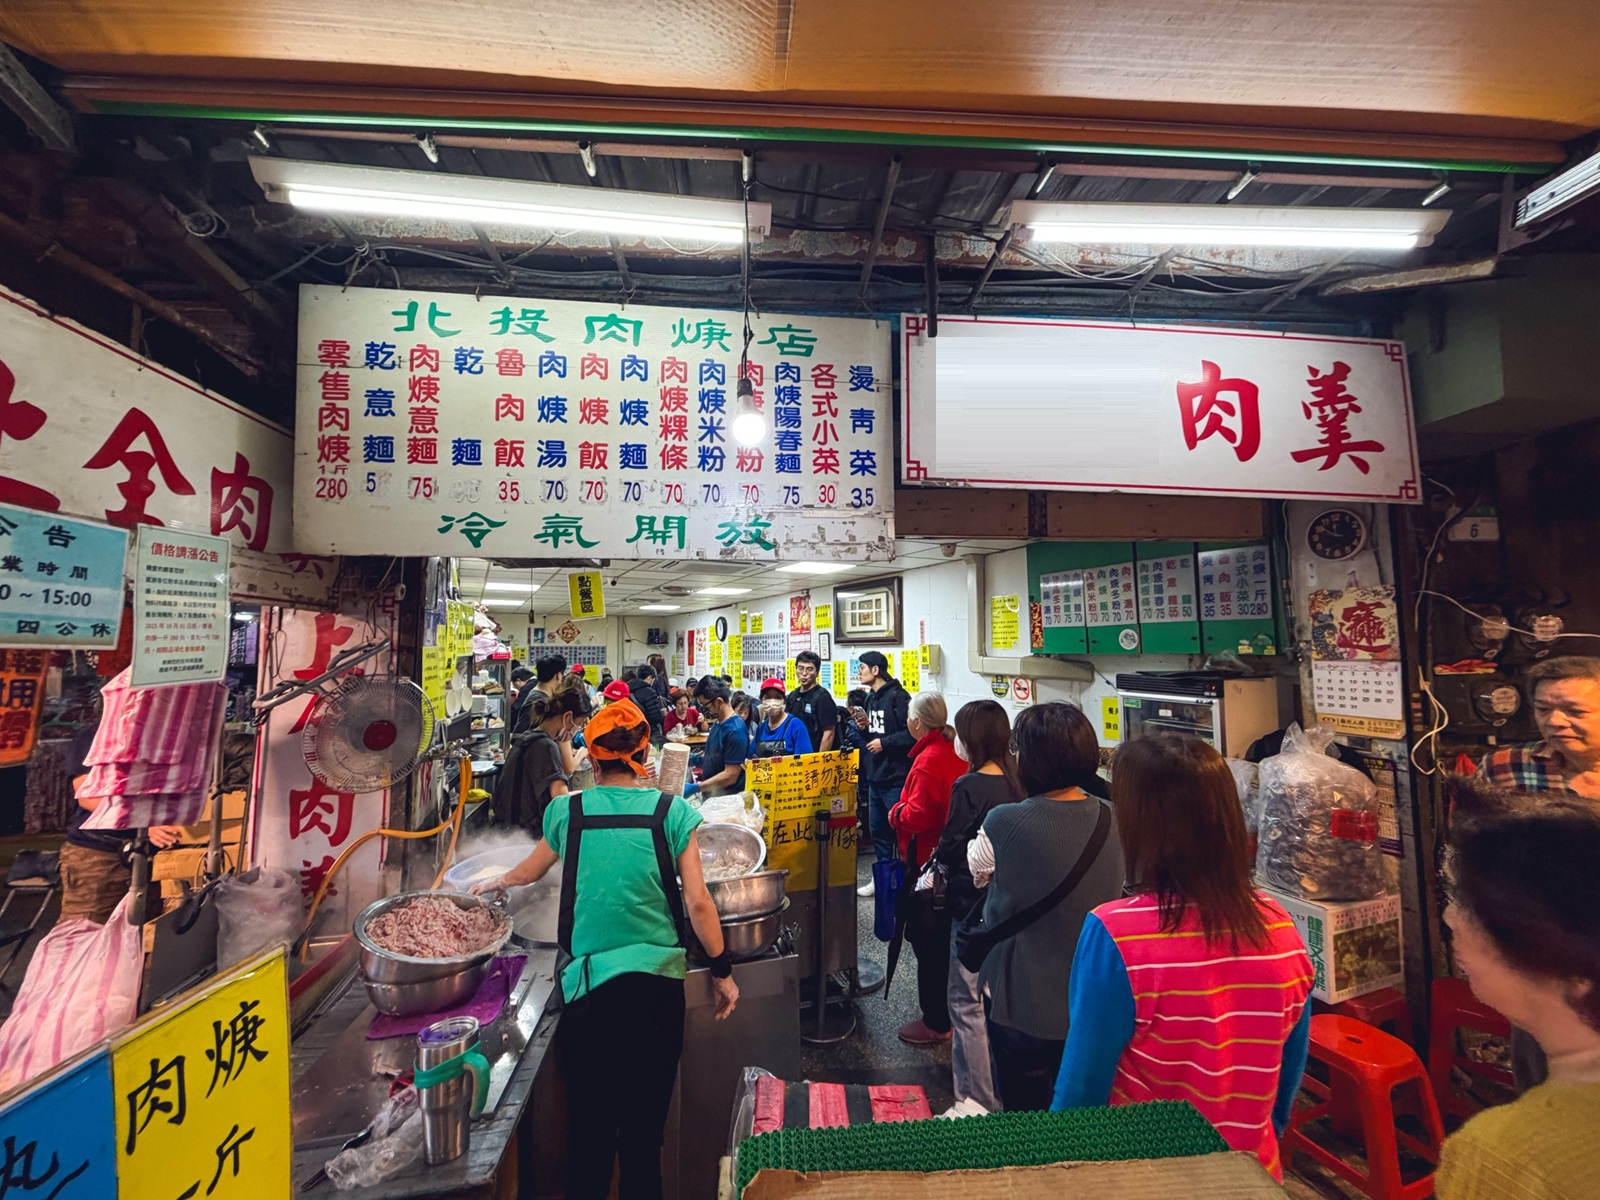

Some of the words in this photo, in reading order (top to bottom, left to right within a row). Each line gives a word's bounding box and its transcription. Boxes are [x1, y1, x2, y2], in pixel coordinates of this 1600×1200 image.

[363, 341, 396, 464] 乾意麵
[451, 346, 484, 466] 乾麵
[494, 348, 526, 468] 魯肉飯
[735, 360, 764, 473] 肉粉
[810, 363, 840, 475] 各式小菜
[848, 365, 877, 477] 燙青菜
[1176, 359, 1387, 475] 肉羹
[315, 477, 348, 499] 280
[366, 472, 376, 492] 5
[411, 476, 433, 498] 75
[498, 480, 520, 501] 35
[545, 480, 565, 501] 70
[585, 480, 604, 501] 70
[623, 481, 642, 501] 70
[664, 484, 683, 503] 70
[702, 484, 721, 503] 70
[741, 484, 760, 503] 70
[782, 486, 800, 505] 75
[818, 484, 836, 504] 30
[851, 487, 875, 509] 35
[437, 511, 777, 550] 冷氣開放
[1471, 523, 1479, 537] 6
[151, 542, 219, 563] 價格調漲公告
[1235, 552, 1250, 602] 各式小菜
[42, 588, 92, 607] 15:00
[577, 574, 595, 614] 點餐區
[1064, 614, 1073, 623] 75
[1074, 613, 1083, 622] 70
[1089, 612, 1098, 623] 70
[1101, 612, 1110, 622] 70
[1112, 612, 1121, 622] 70
[1125, 610, 1134, 621] 70
[1142, 608, 1153, 619] 70
[1155, 608, 1165, 619] 75
[1168, 606, 1179, 617] 55
[1182, 606, 1192, 617] 50
[1204, 605, 1215, 617] 35
[1221, 604, 1232, 616] 35
[1237, 603, 1249, 615] 30
[1250, 602, 1268, 616] 280
[1045, 616, 1053, 625] 70
[1054, 615, 1061, 624] 70
[774, 821, 856, 849] 在此隊
